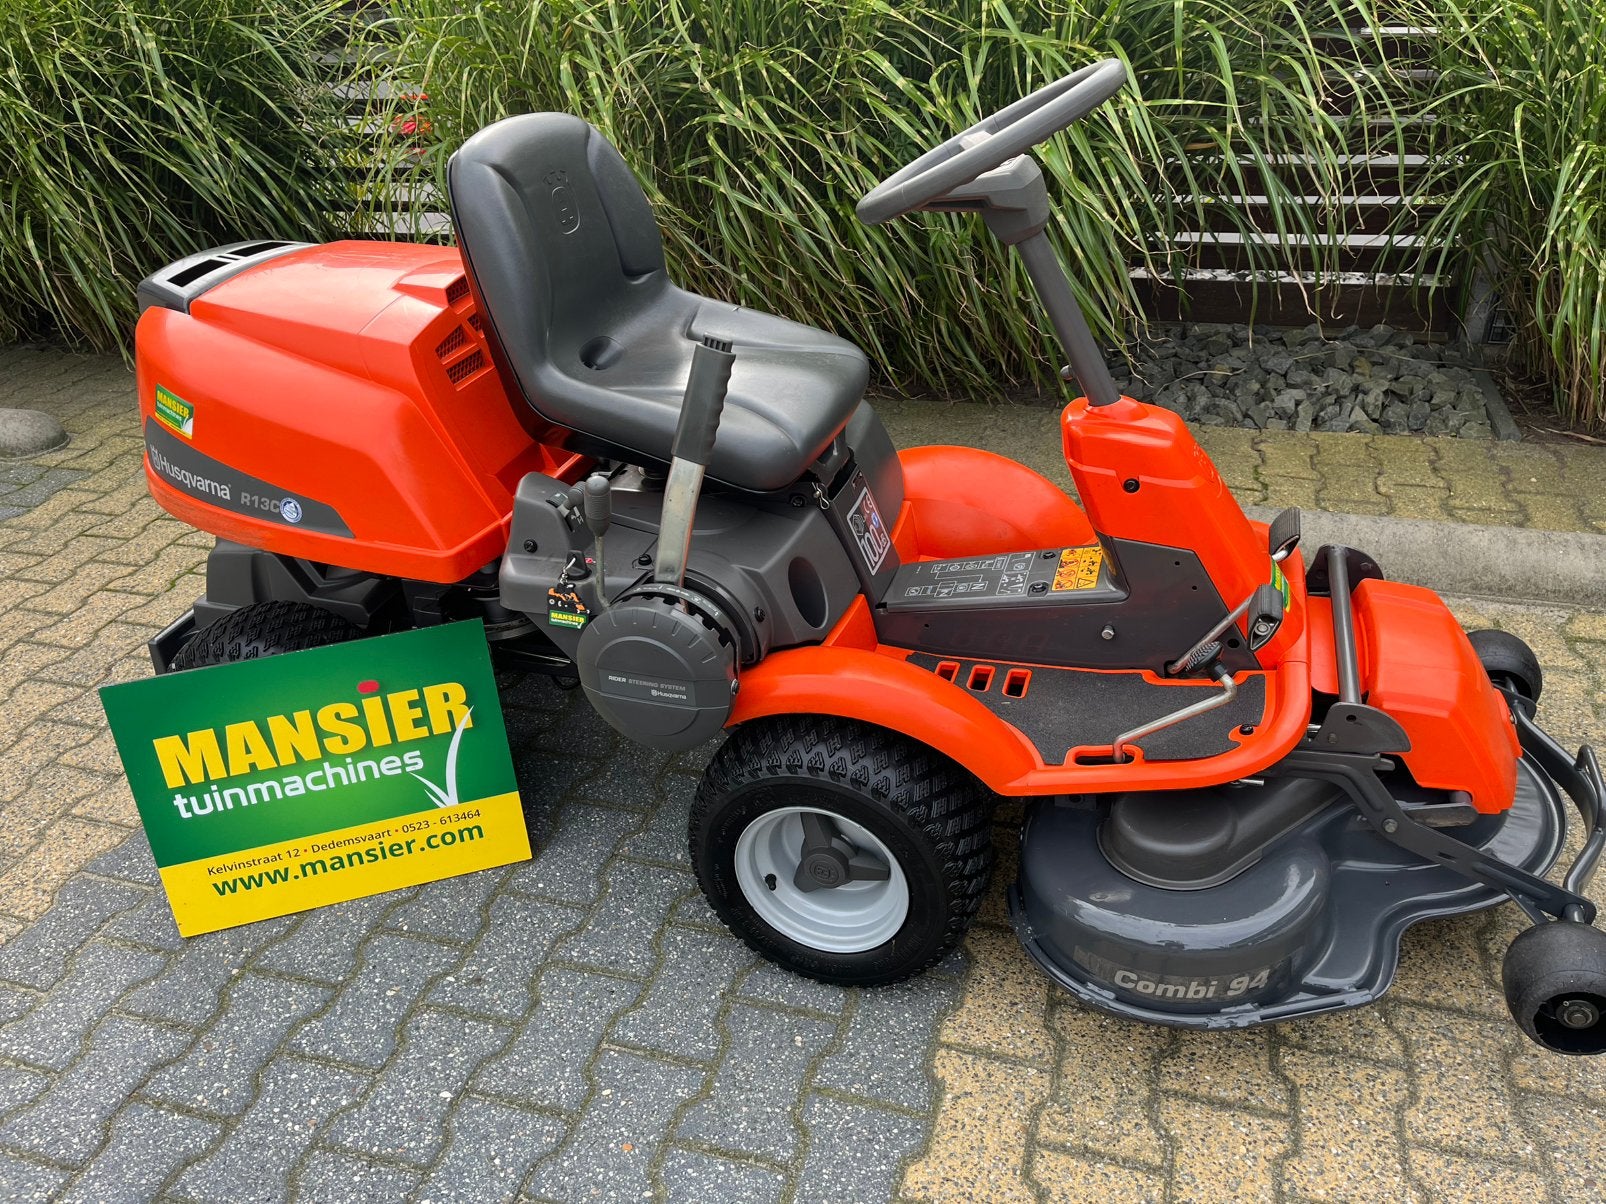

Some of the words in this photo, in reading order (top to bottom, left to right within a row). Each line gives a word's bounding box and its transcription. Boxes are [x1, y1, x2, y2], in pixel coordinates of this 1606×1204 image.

[156, 390, 190, 418] MANSIER
[158, 453, 231, 500] Husqvarna
[608, 675, 627, 683] RIDER
[628, 678, 659, 688] STEERING
[659, 683, 686, 691] SYSTEM
[657, 690, 687, 700] Husqvarna
[152, 680, 474, 789] MANSIER
[173, 749, 424, 819] tuinmachines
[207, 852, 284, 876] Kelvinstraat
[286, 847, 301, 860] 12
[310, 828, 393, 855] Dedemsvaart
[401, 819, 430, 834] 0523
[439, 808, 481, 827] 613464
[211, 823, 485, 897] www.mansier.com
[1114, 969, 1217, 999] Combi
[1226, 968, 1270, 996] 94
